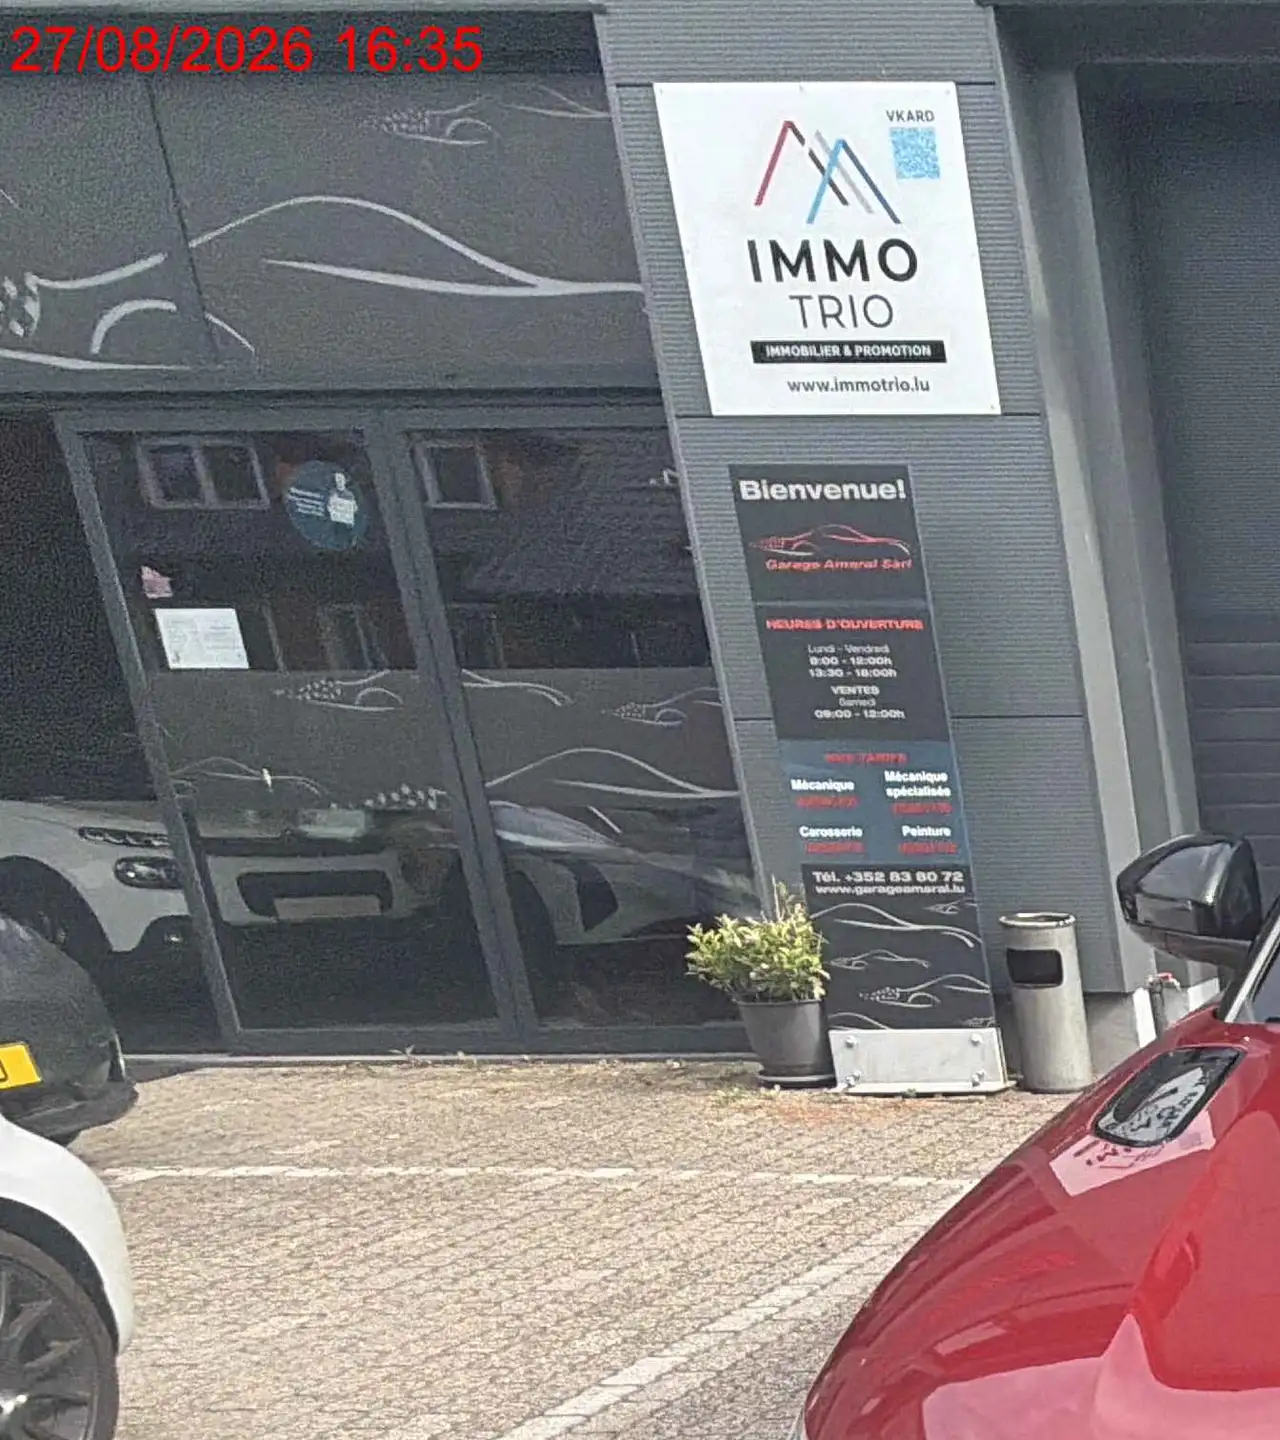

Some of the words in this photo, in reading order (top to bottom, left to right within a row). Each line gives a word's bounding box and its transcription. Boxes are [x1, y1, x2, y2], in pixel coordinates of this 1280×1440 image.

[886, 110, 936, 122] VKARD
[747, 238, 918, 283] IMMO
[788, 294, 894, 329] TRIO
[765, 344, 841, 357] IMMOBILIER
[843, 345, 852, 357] &
[855, 344, 932, 357] PROMOTION
[787, 376, 930, 392] www.immotrio.lu
[738, 479, 907, 501] Bienvenue!
[765, 559, 821, 571] Garage
[824, 559, 878, 569] Amaral
[765, 619, 823, 630] HEURES
[826, 619, 925, 630] D'OUVERTURE
[884, 770, 949, 784] Mécanique
[790, 779, 855, 793] Mécanique
[901, 825, 952, 837] Peinture
[812, 871, 841, 883] Tél.
[845, 871, 886, 883] +352
[942, 871, 965, 882] 72
[815, 884, 966, 896] www.garageamaral.lu
